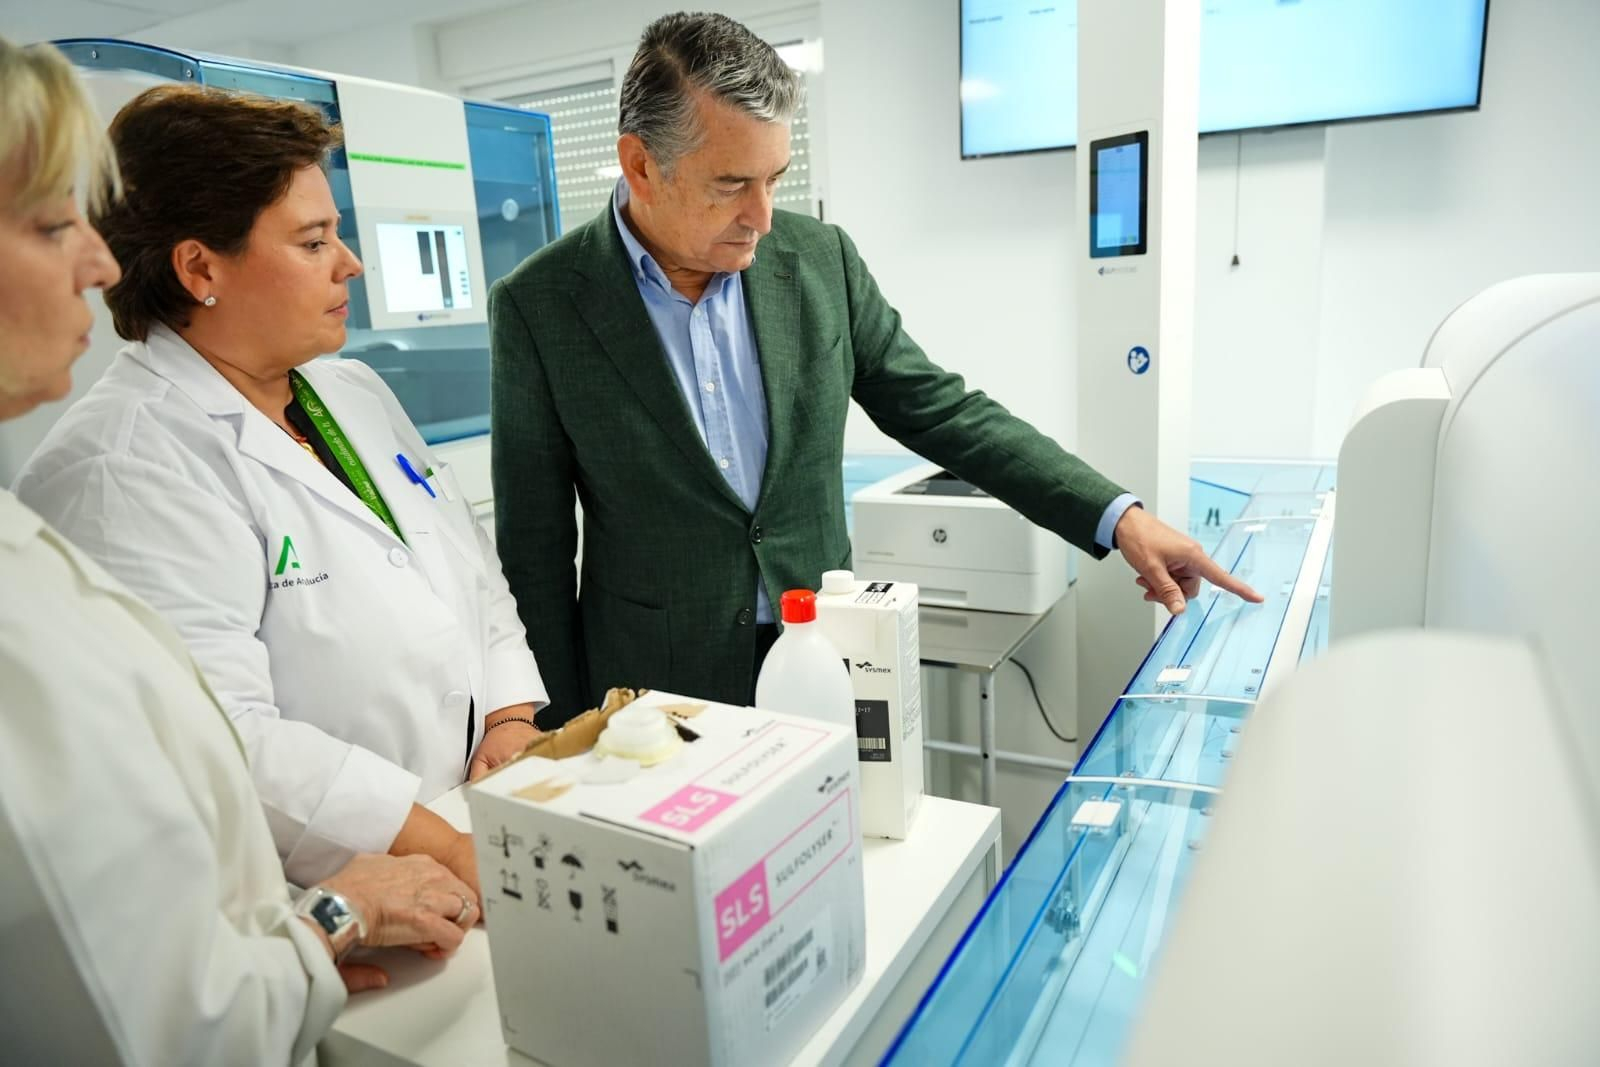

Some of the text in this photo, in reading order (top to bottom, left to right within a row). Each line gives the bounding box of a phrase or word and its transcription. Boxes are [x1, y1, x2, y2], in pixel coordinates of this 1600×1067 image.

[282, 578, 294, 587] de
[660, 791, 719, 826] SLS
[720, 882, 764, 938] SLS
